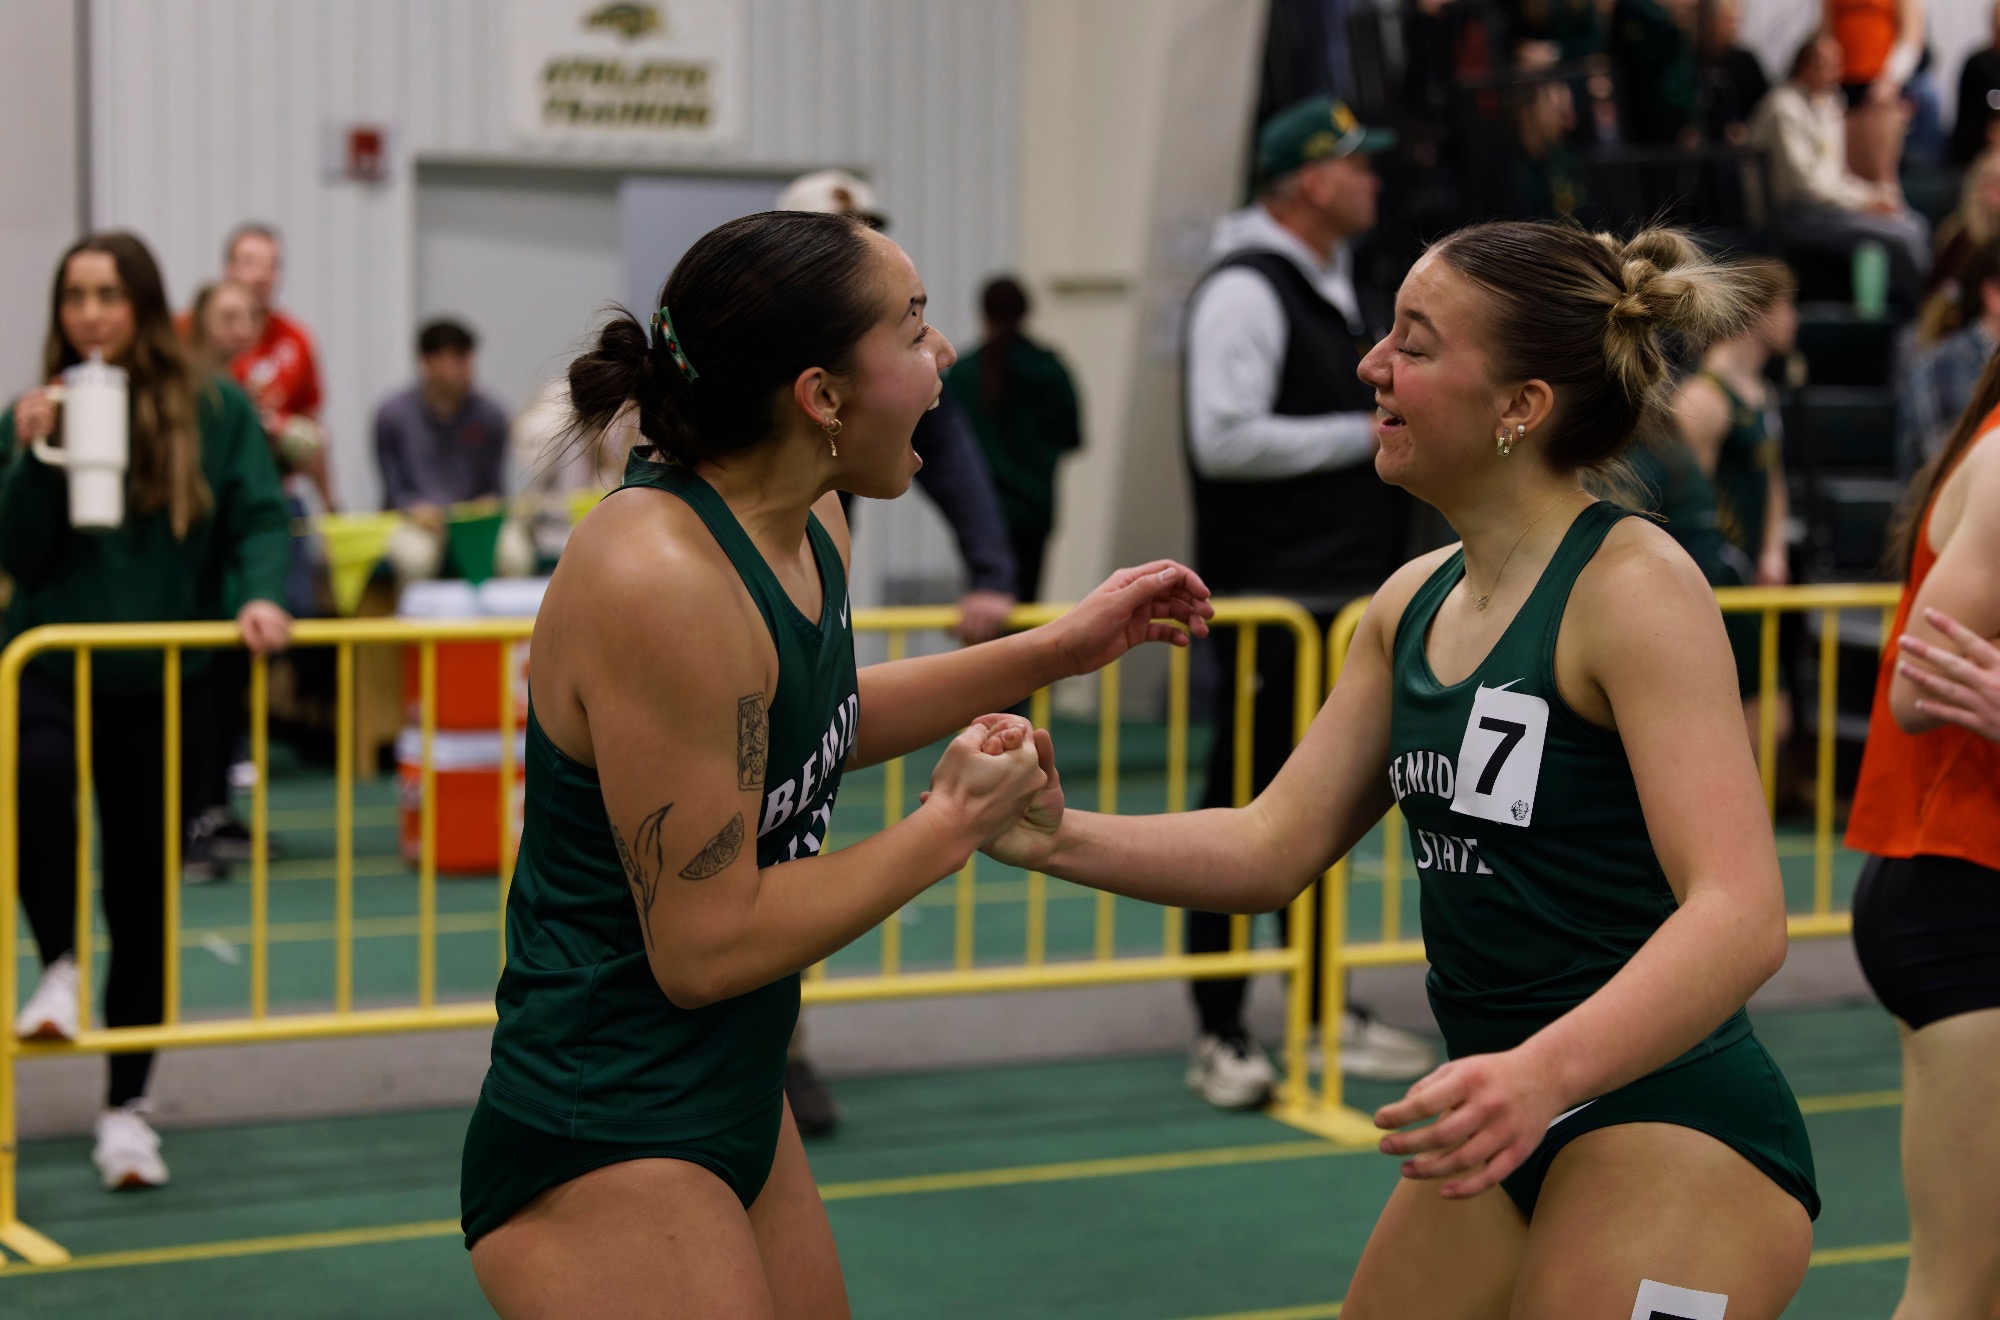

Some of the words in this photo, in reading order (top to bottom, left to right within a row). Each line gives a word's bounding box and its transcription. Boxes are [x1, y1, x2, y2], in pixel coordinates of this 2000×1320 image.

[541, 55, 711, 88] ATHLETIC
[541, 97, 711, 129] TRAINING
[1475, 716, 1527, 796] 7
[1417, 829, 1494, 875] STATE
